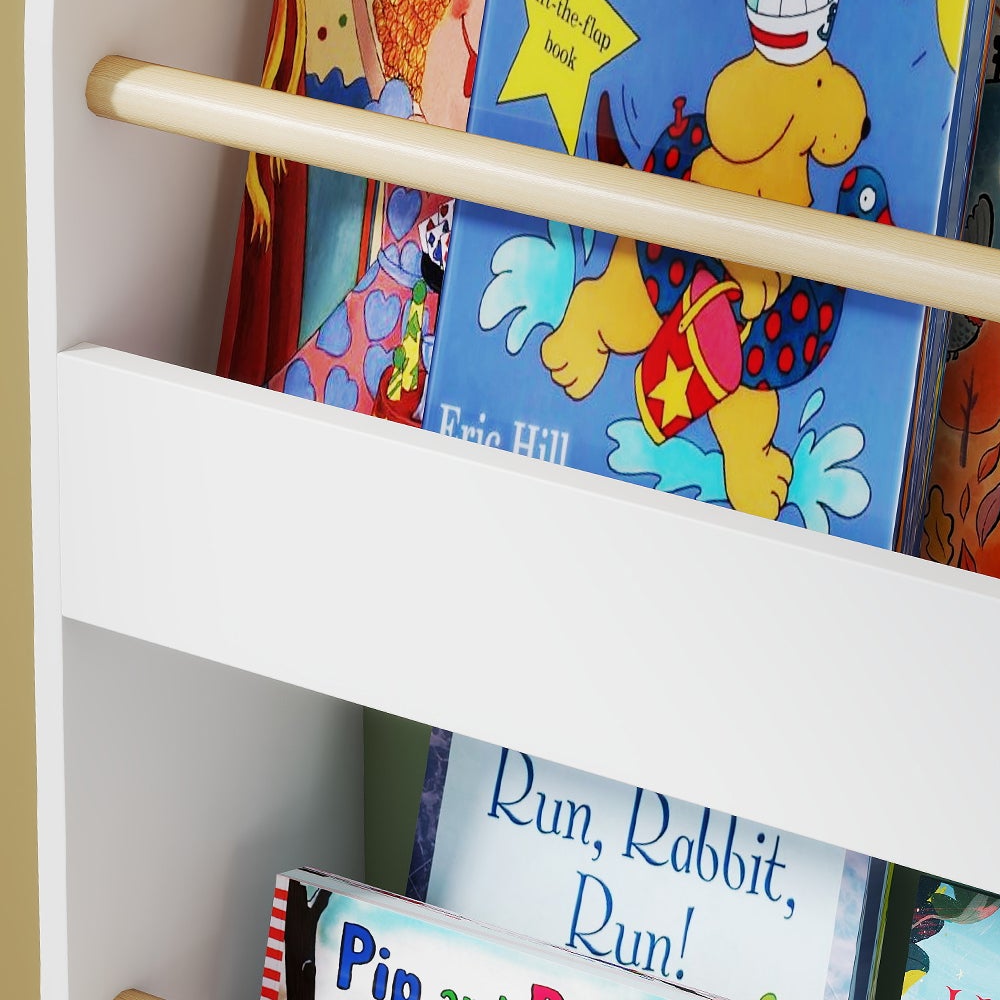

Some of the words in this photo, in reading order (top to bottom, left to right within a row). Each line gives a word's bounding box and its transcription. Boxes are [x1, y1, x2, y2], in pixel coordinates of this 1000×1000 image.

[544, 30, 577, 71] book
[512, 420, 569, 466] Hill
[488, 746, 602, 862] Run,
[621, 787, 797, 920] Rabbit,
[565, 871, 696, 980] Run!
